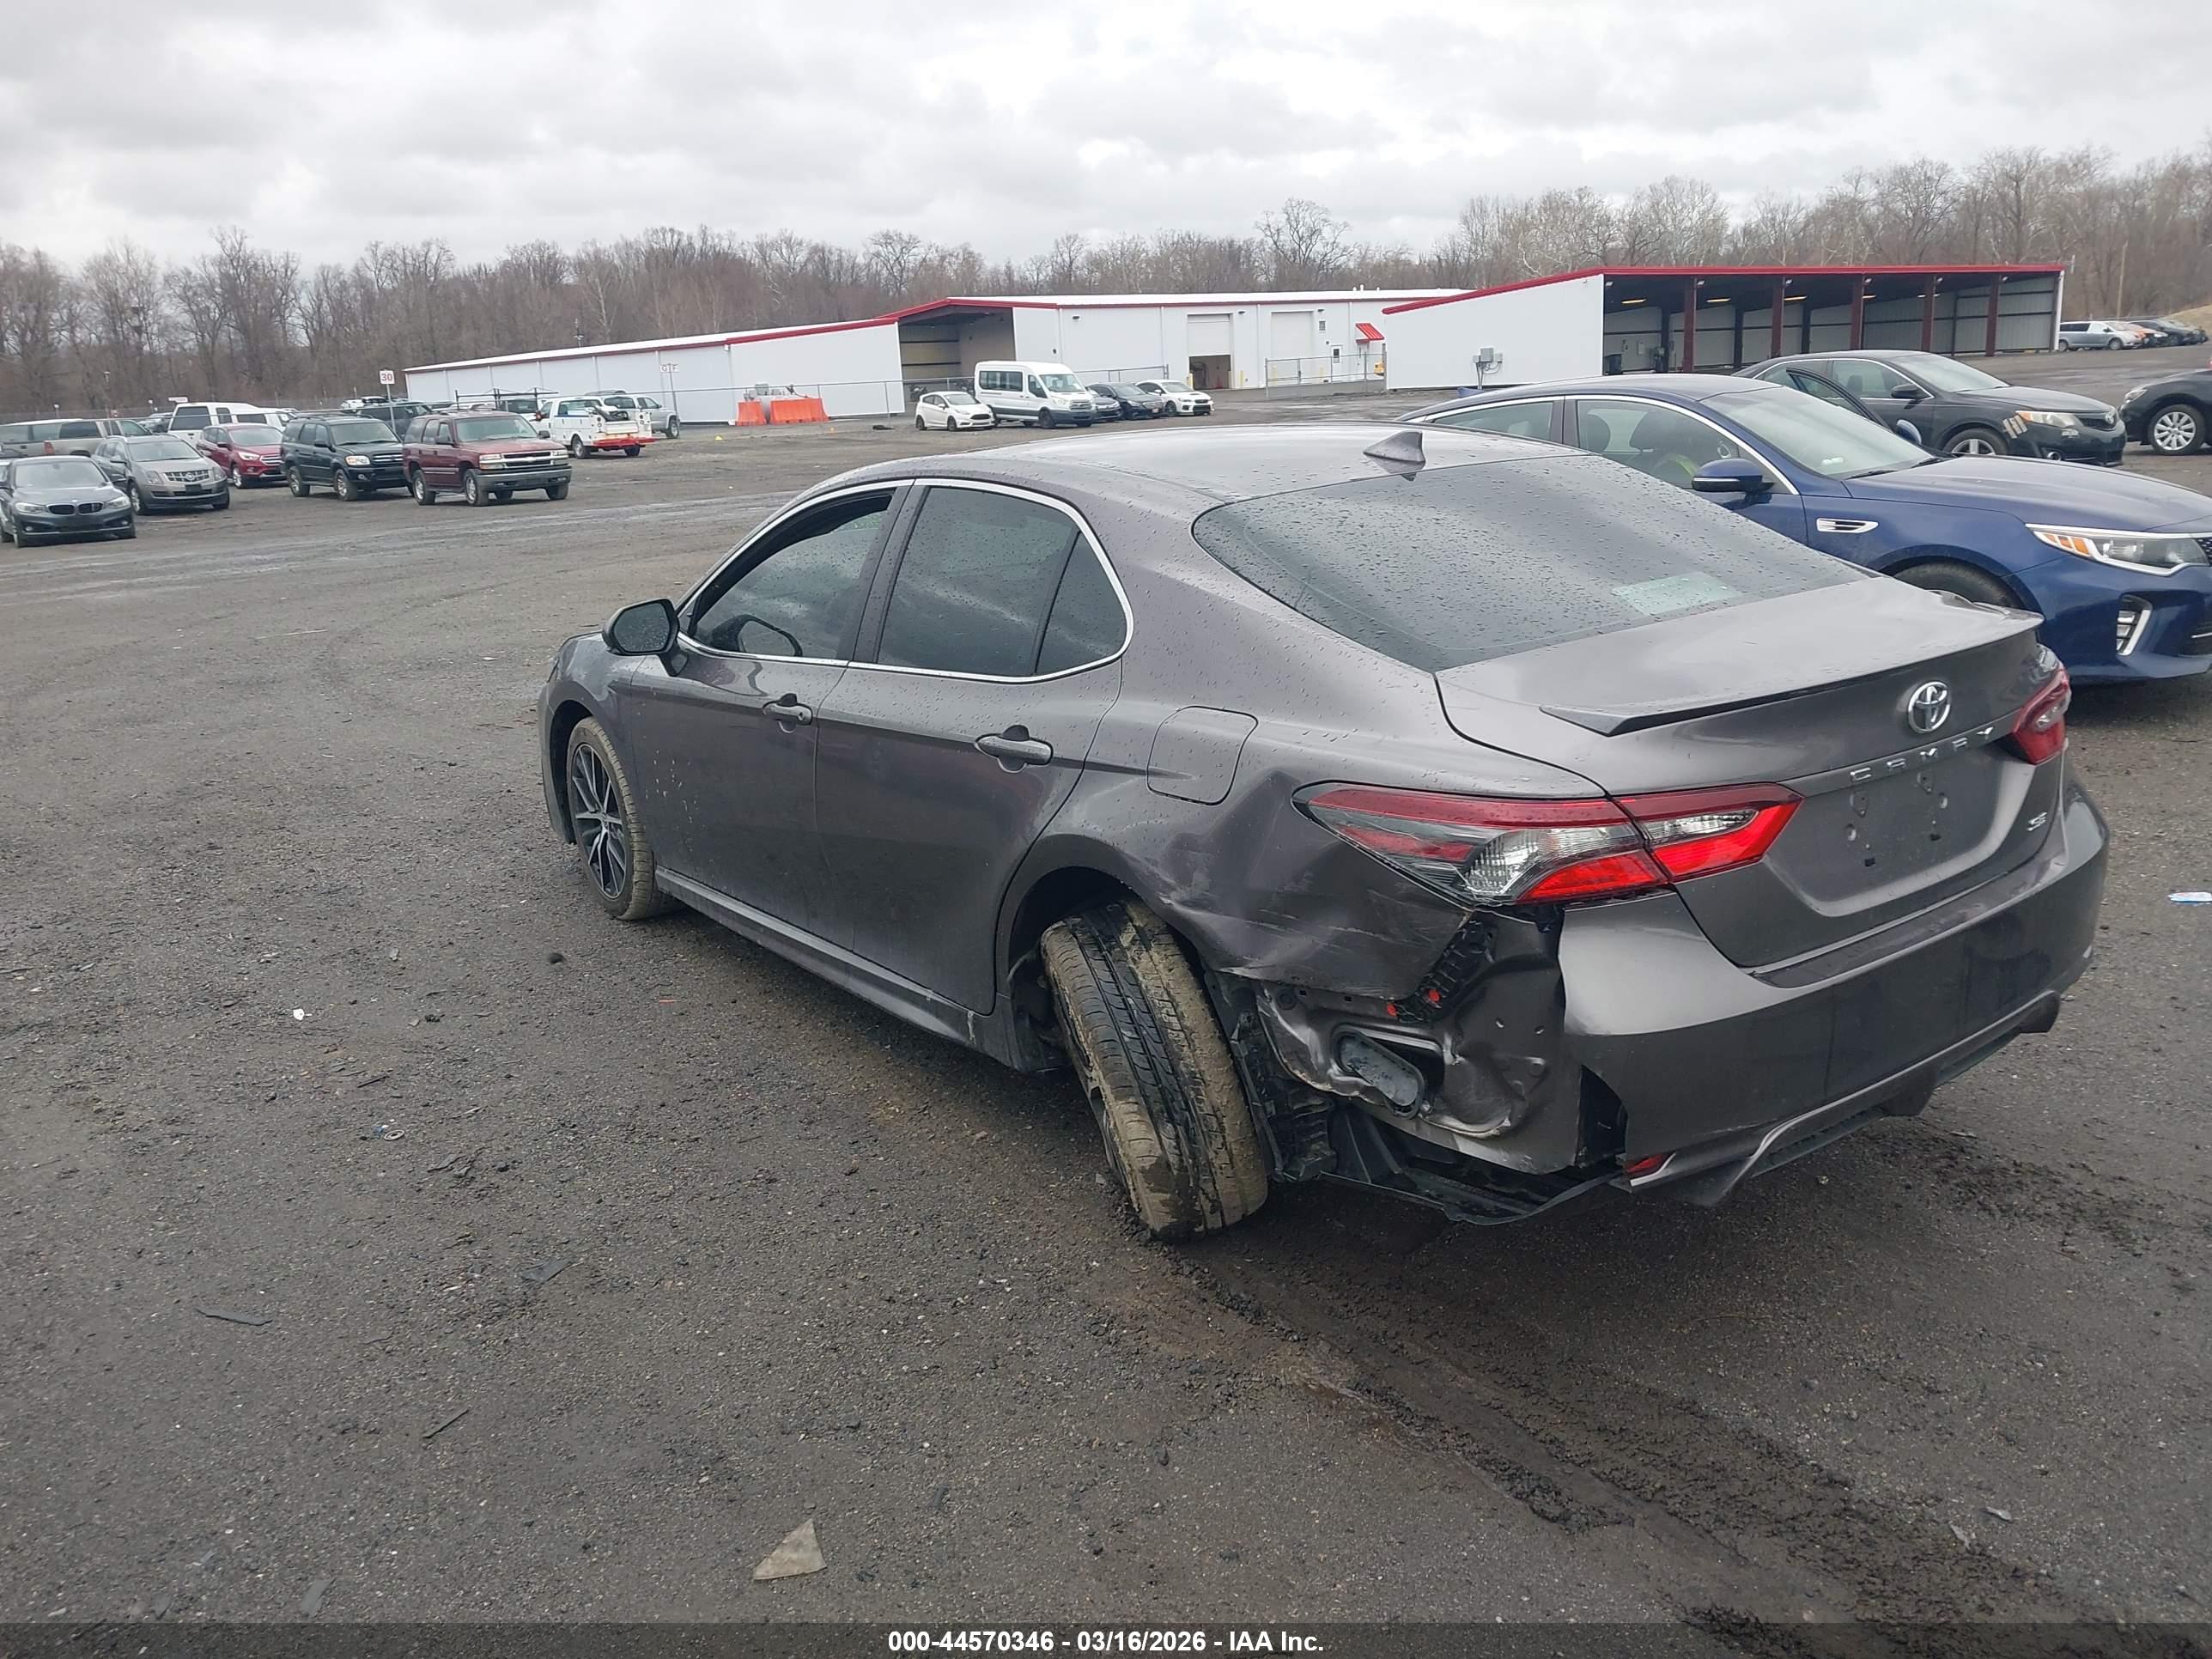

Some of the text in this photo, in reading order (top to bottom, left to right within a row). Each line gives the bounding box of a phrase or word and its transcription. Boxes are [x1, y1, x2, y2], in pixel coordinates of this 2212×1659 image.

[380, 373, 393, 381] 30
[1850, 726, 1995, 781] CAMRY
[2027, 811, 2048, 831] SE
